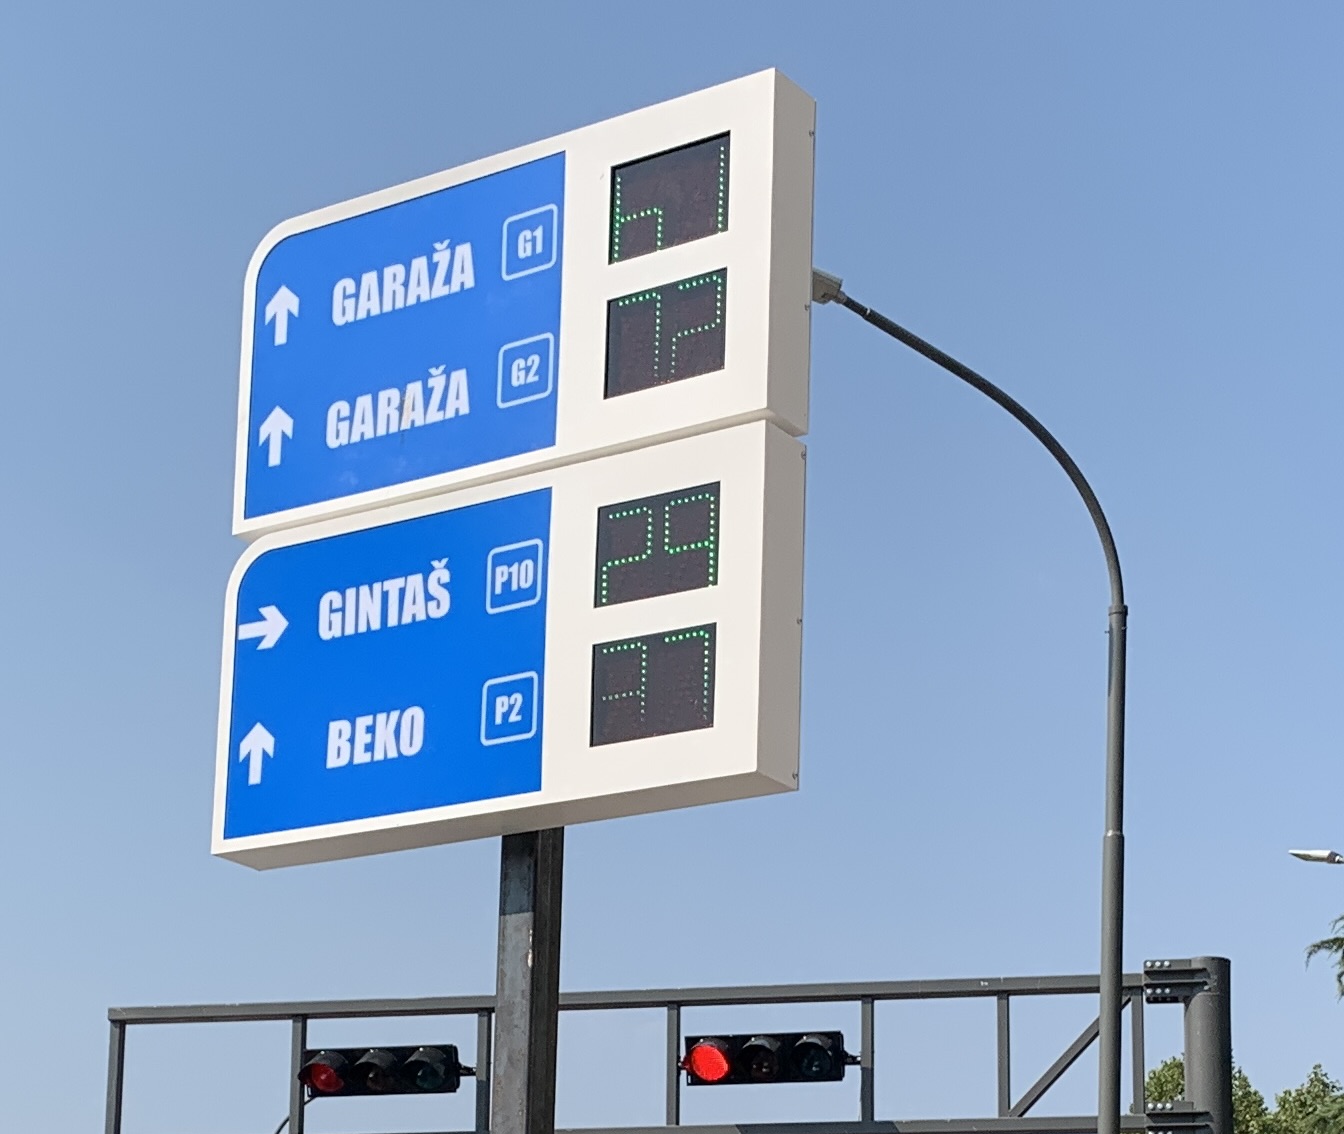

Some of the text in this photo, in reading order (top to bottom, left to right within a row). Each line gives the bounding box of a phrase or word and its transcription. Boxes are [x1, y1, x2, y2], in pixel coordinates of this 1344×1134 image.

[333, 225, 543, 325] GARAŽA G1
[327, 355, 539, 448] GARAŽA G2
[319, 559, 533, 639] GINTAŠ P10
[327, 694, 522, 768] BEKO P2
